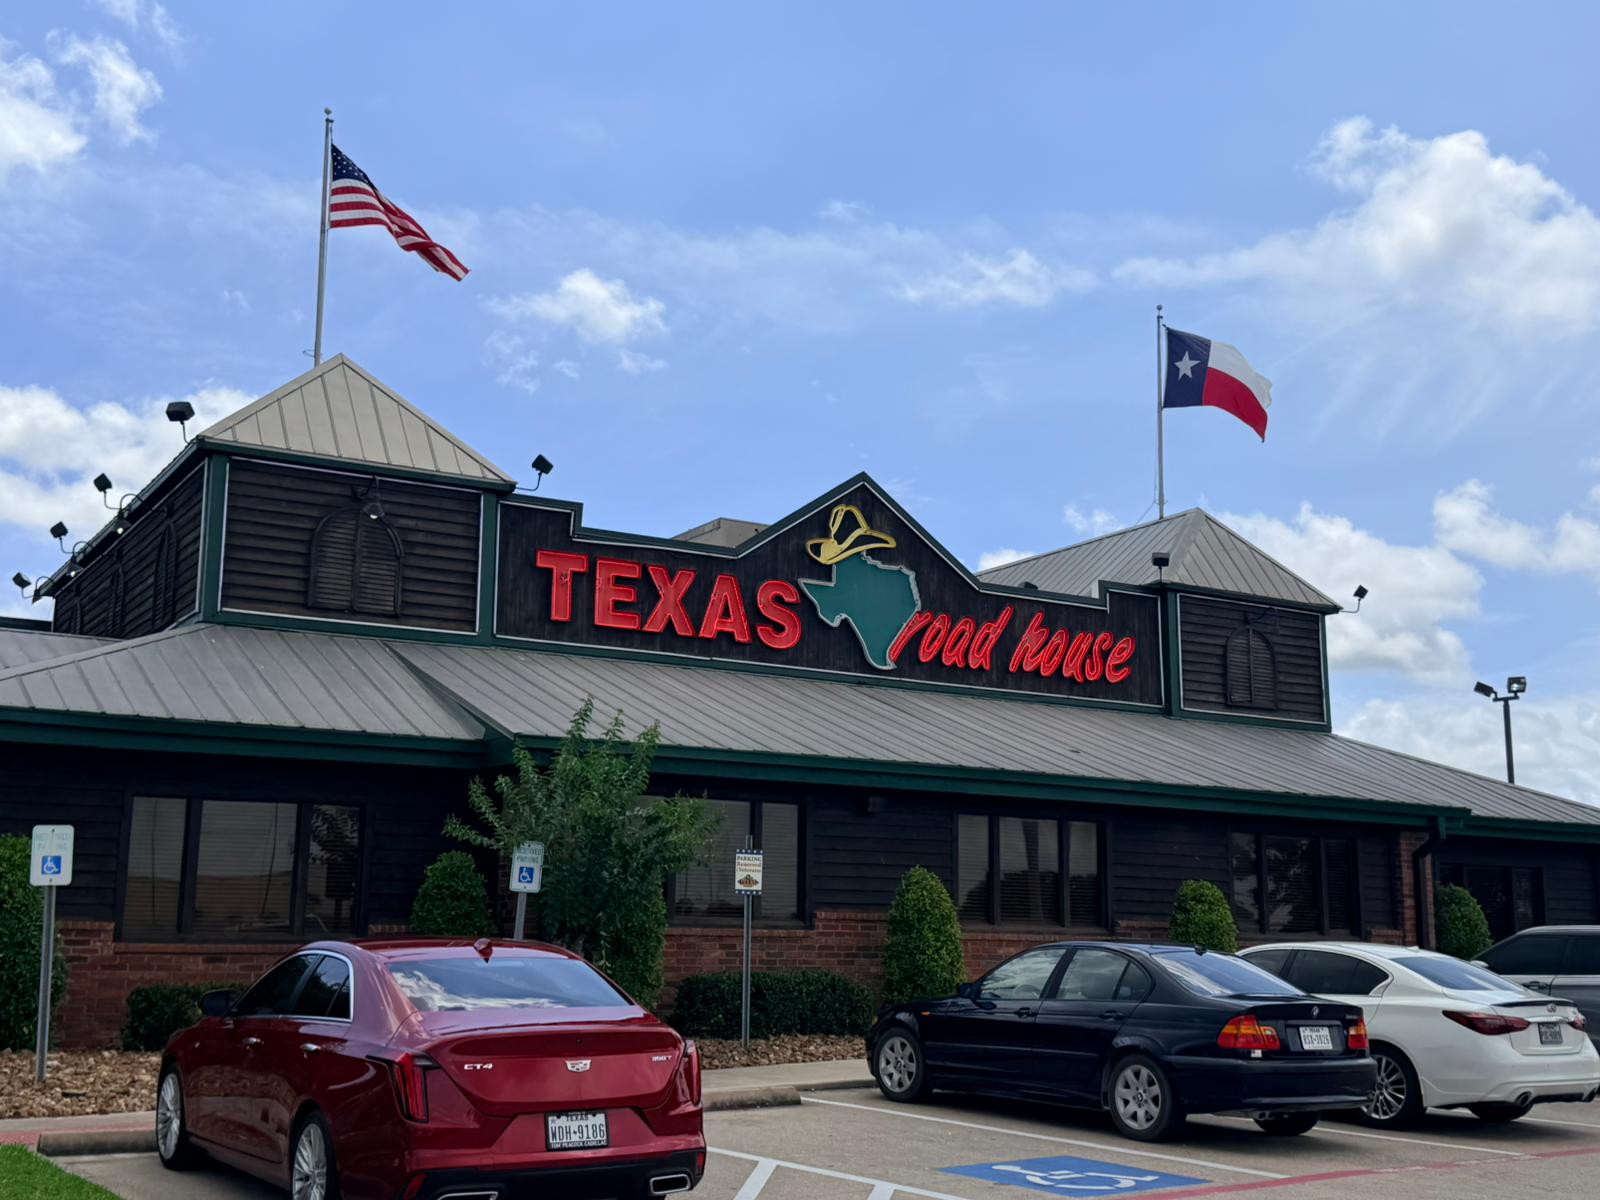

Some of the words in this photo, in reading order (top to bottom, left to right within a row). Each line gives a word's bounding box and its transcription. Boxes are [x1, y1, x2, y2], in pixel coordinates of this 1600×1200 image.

[536, 549, 801, 650] TEXAS
[887, 605, 1014, 672] road
[1009, 610, 1136, 684] house
[464, 1063, 493, 1071] CT4
[566, 1113, 589, 1122] TEXAS
